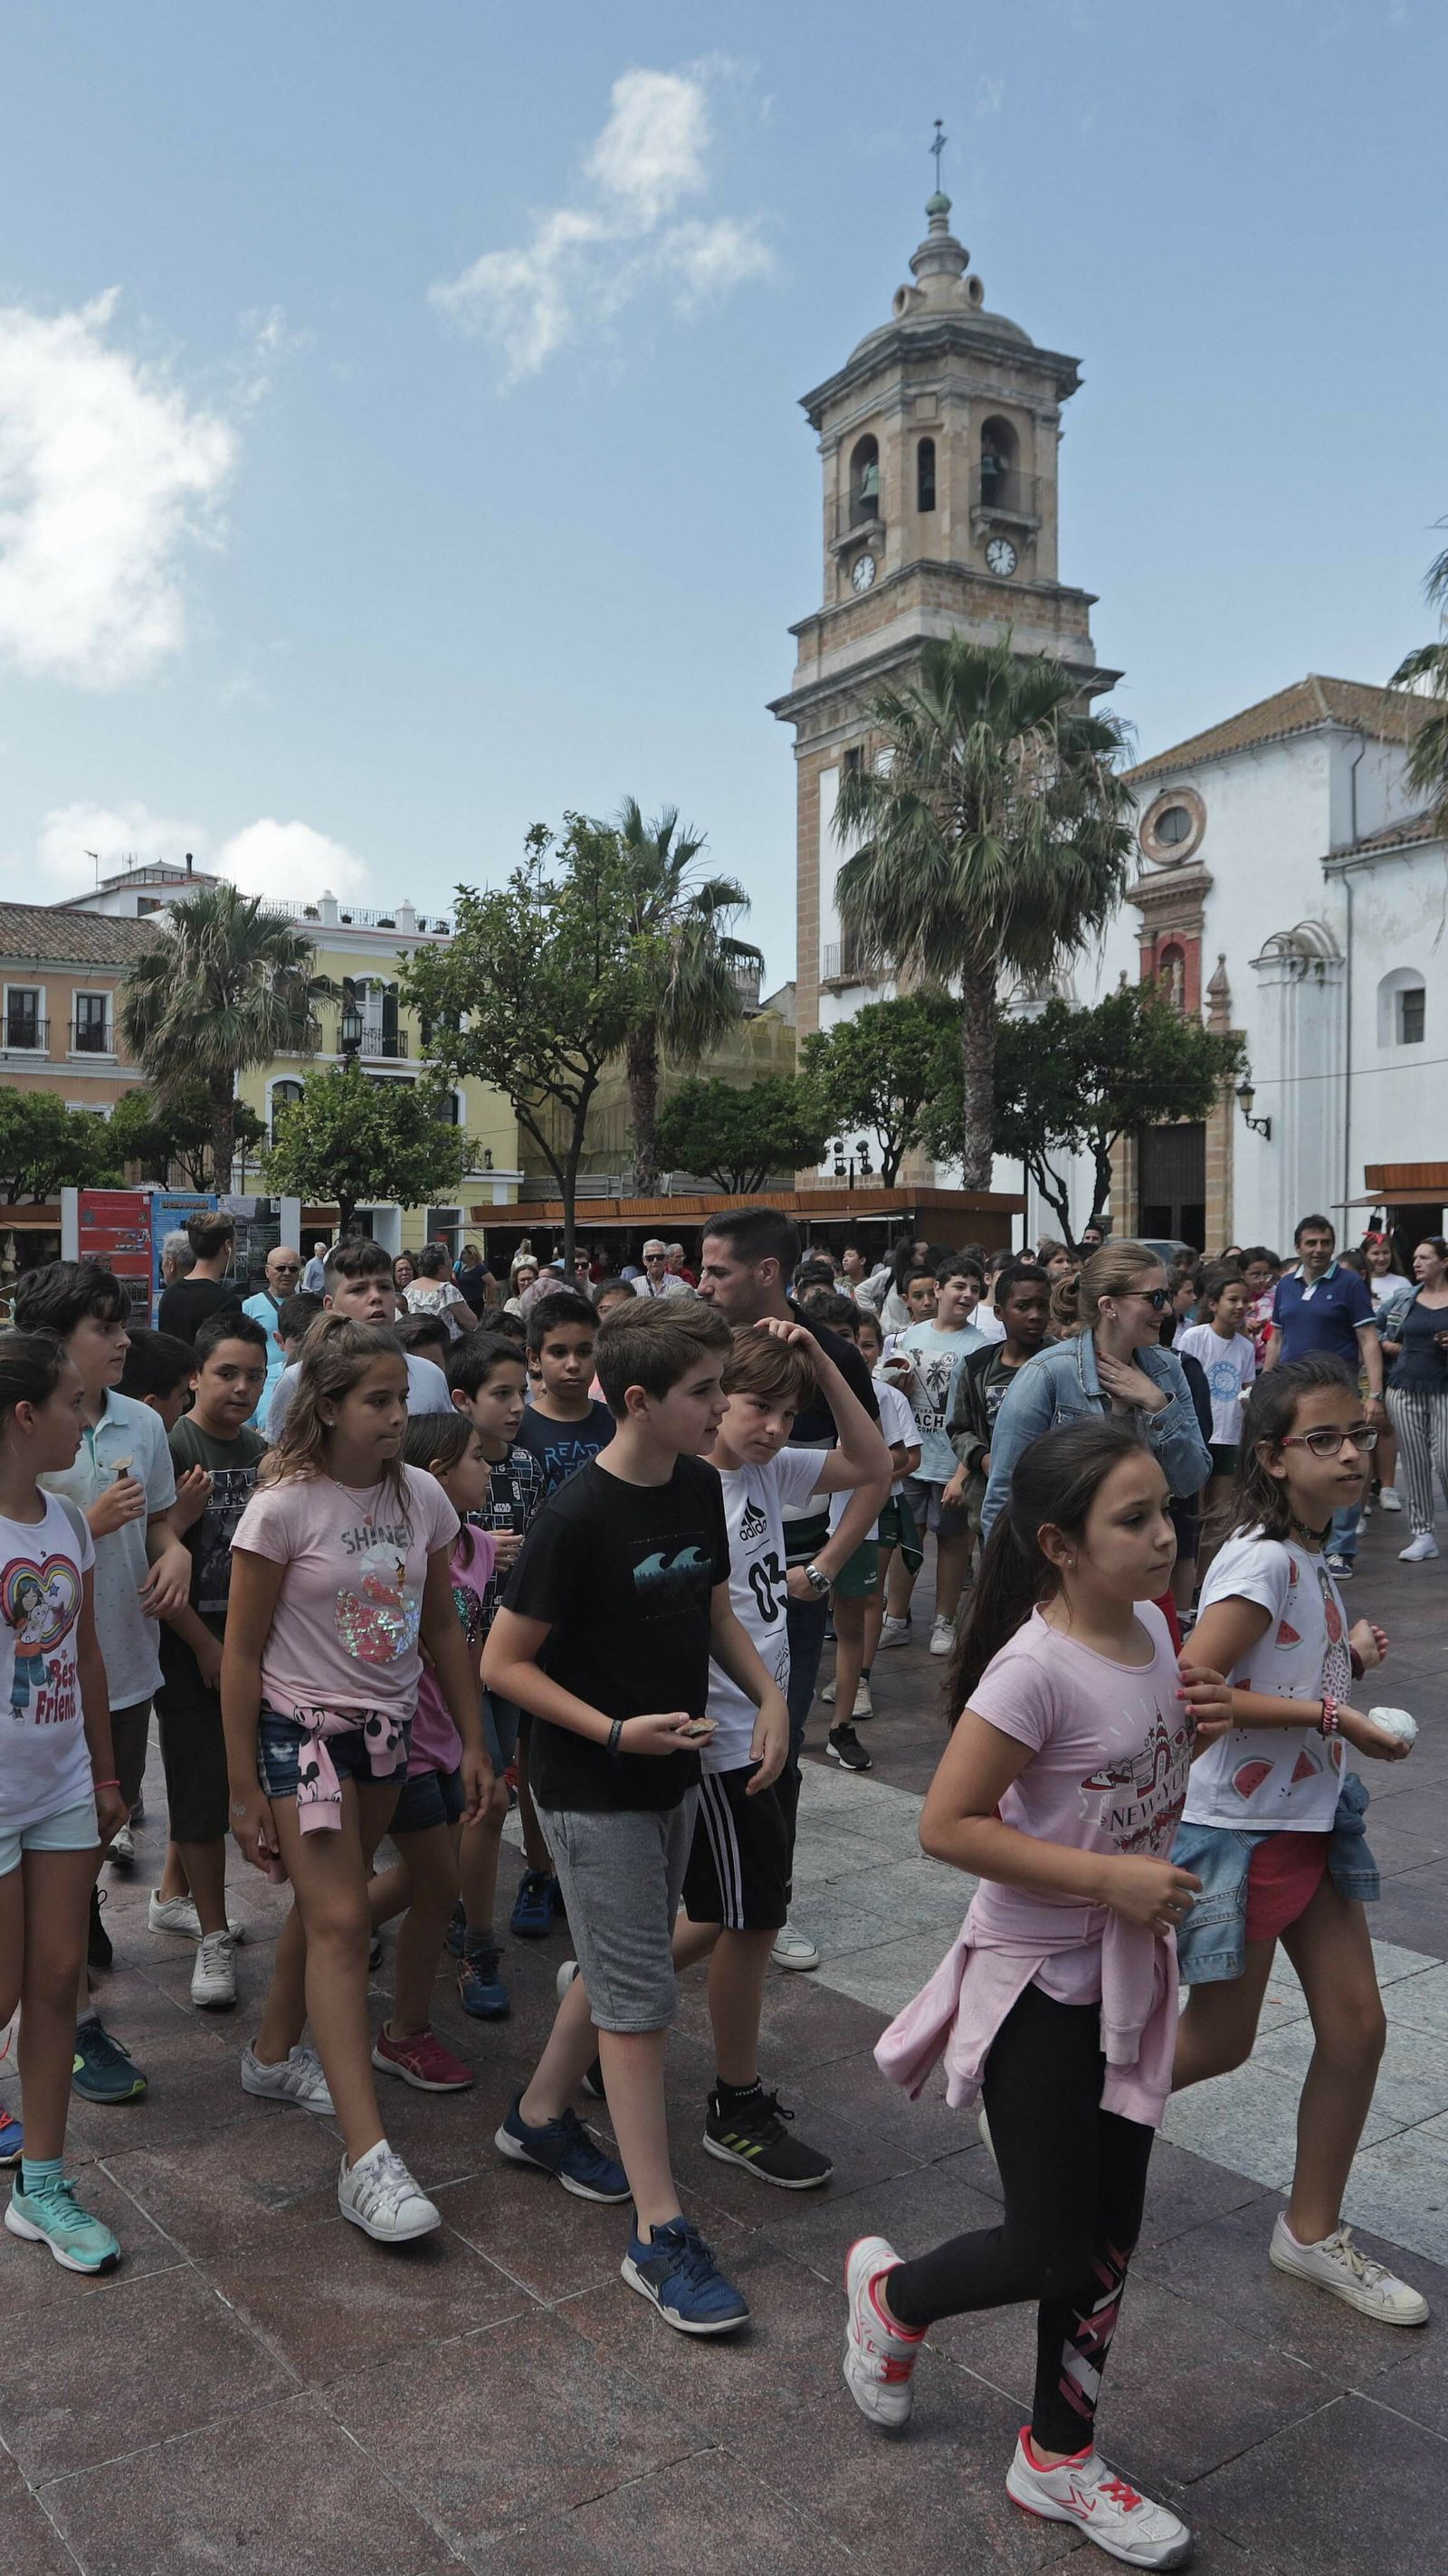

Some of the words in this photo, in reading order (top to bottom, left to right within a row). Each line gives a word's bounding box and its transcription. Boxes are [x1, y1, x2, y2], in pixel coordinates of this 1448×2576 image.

[914, 1413, 944, 1428] ACH
[544, 1440, 605, 1474] READ
[739, 1519, 767, 1542] adida
[1111, 1798, 1155, 1830] NEW
